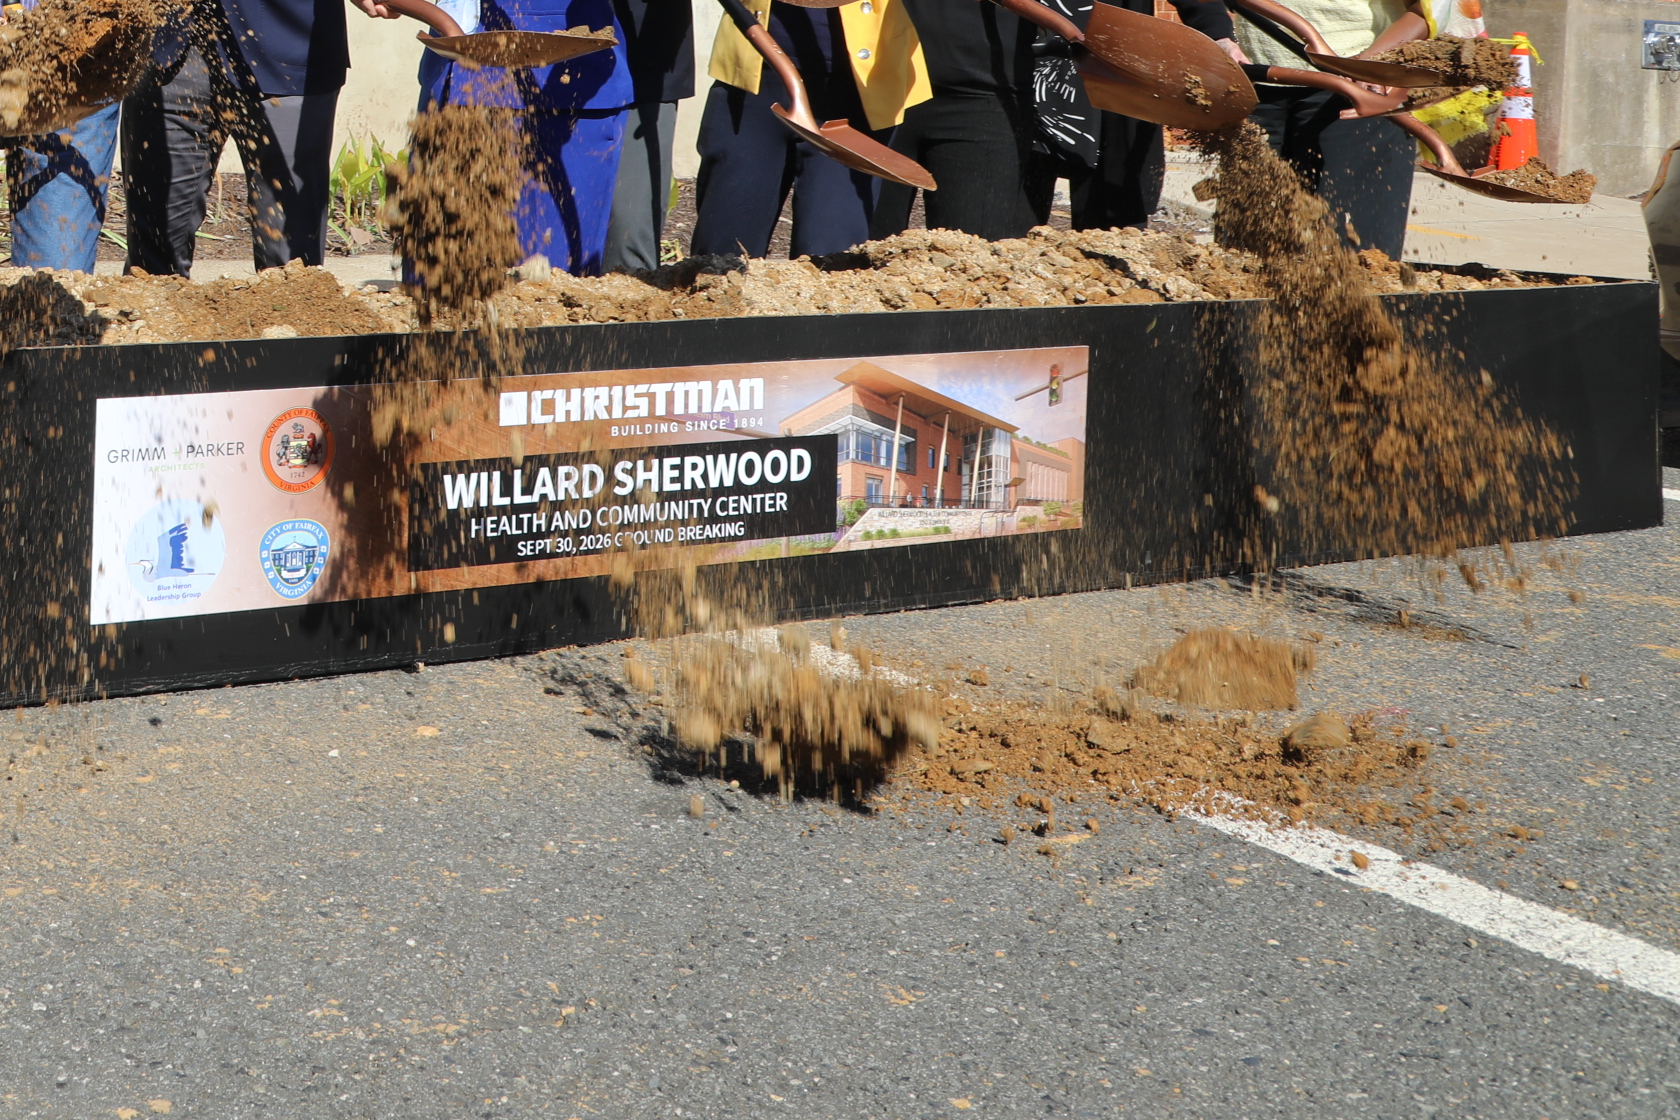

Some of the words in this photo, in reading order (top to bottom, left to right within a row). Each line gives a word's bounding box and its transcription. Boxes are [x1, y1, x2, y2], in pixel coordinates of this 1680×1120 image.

[530, 377, 764, 425] CHRISTMAN
[266, 411, 293, 439] COUNTY
[611, 421, 679, 437] BUILDING
[685, 418, 727, 431] SINCE
[733, 416, 764, 428] 1894
[107, 447, 167, 464] GRIMM
[186, 442, 245, 458] PARKER
[148, 463, 205, 473] ARCHITECTS
[443, 463, 605, 510] WILLARD
[612, 448, 813, 496] SHERWOOD
[279, 481, 315, 492] VIRGINIA
[471, 513, 546, 539] HEALTH
[550, 509, 591, 532] AND
[596, 498, 712, 527] COMMUNITY
[715, 492, 788, 517] CENTER
[264, 526, 281, 545] CITY
[282, 522, 294, 531] OF
[295, 522, 325, 540] FAIRFAX
[517, 538, 553, 557] SEPT
[556, 537, 577, 556] 30,
[579, 533, 612, 551] 2026
[677, 521, 745, 542] BREAKING
[146, 593, 180, 602] Leadership
[181, 592, 201, 601] Group
[275, 580, 313, 596] VIRGINIA
